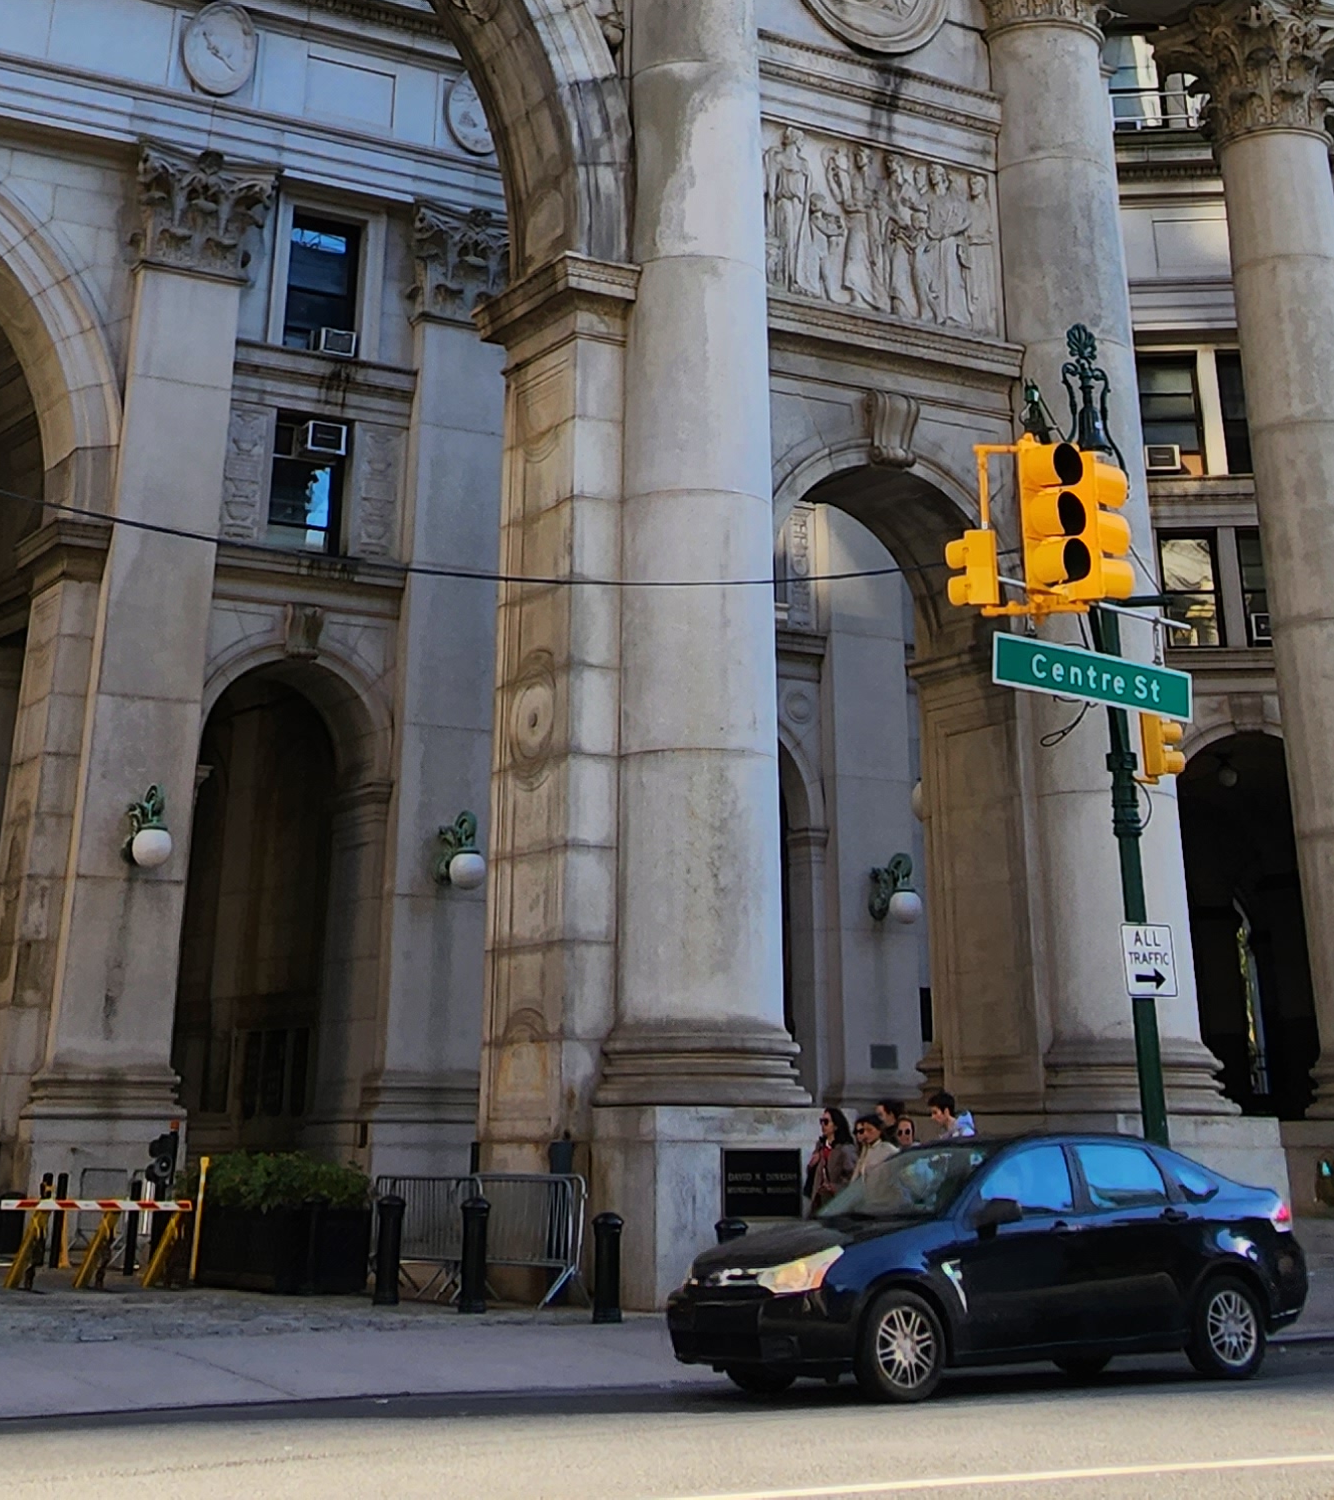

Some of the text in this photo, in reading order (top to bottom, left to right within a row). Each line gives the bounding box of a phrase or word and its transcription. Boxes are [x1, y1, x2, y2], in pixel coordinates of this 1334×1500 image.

[1031, 653, 1161, 703] Centre St
[1133, 929, 1161, 947] ALL
[1128, 951, 1169, 966] TRAFFIC
